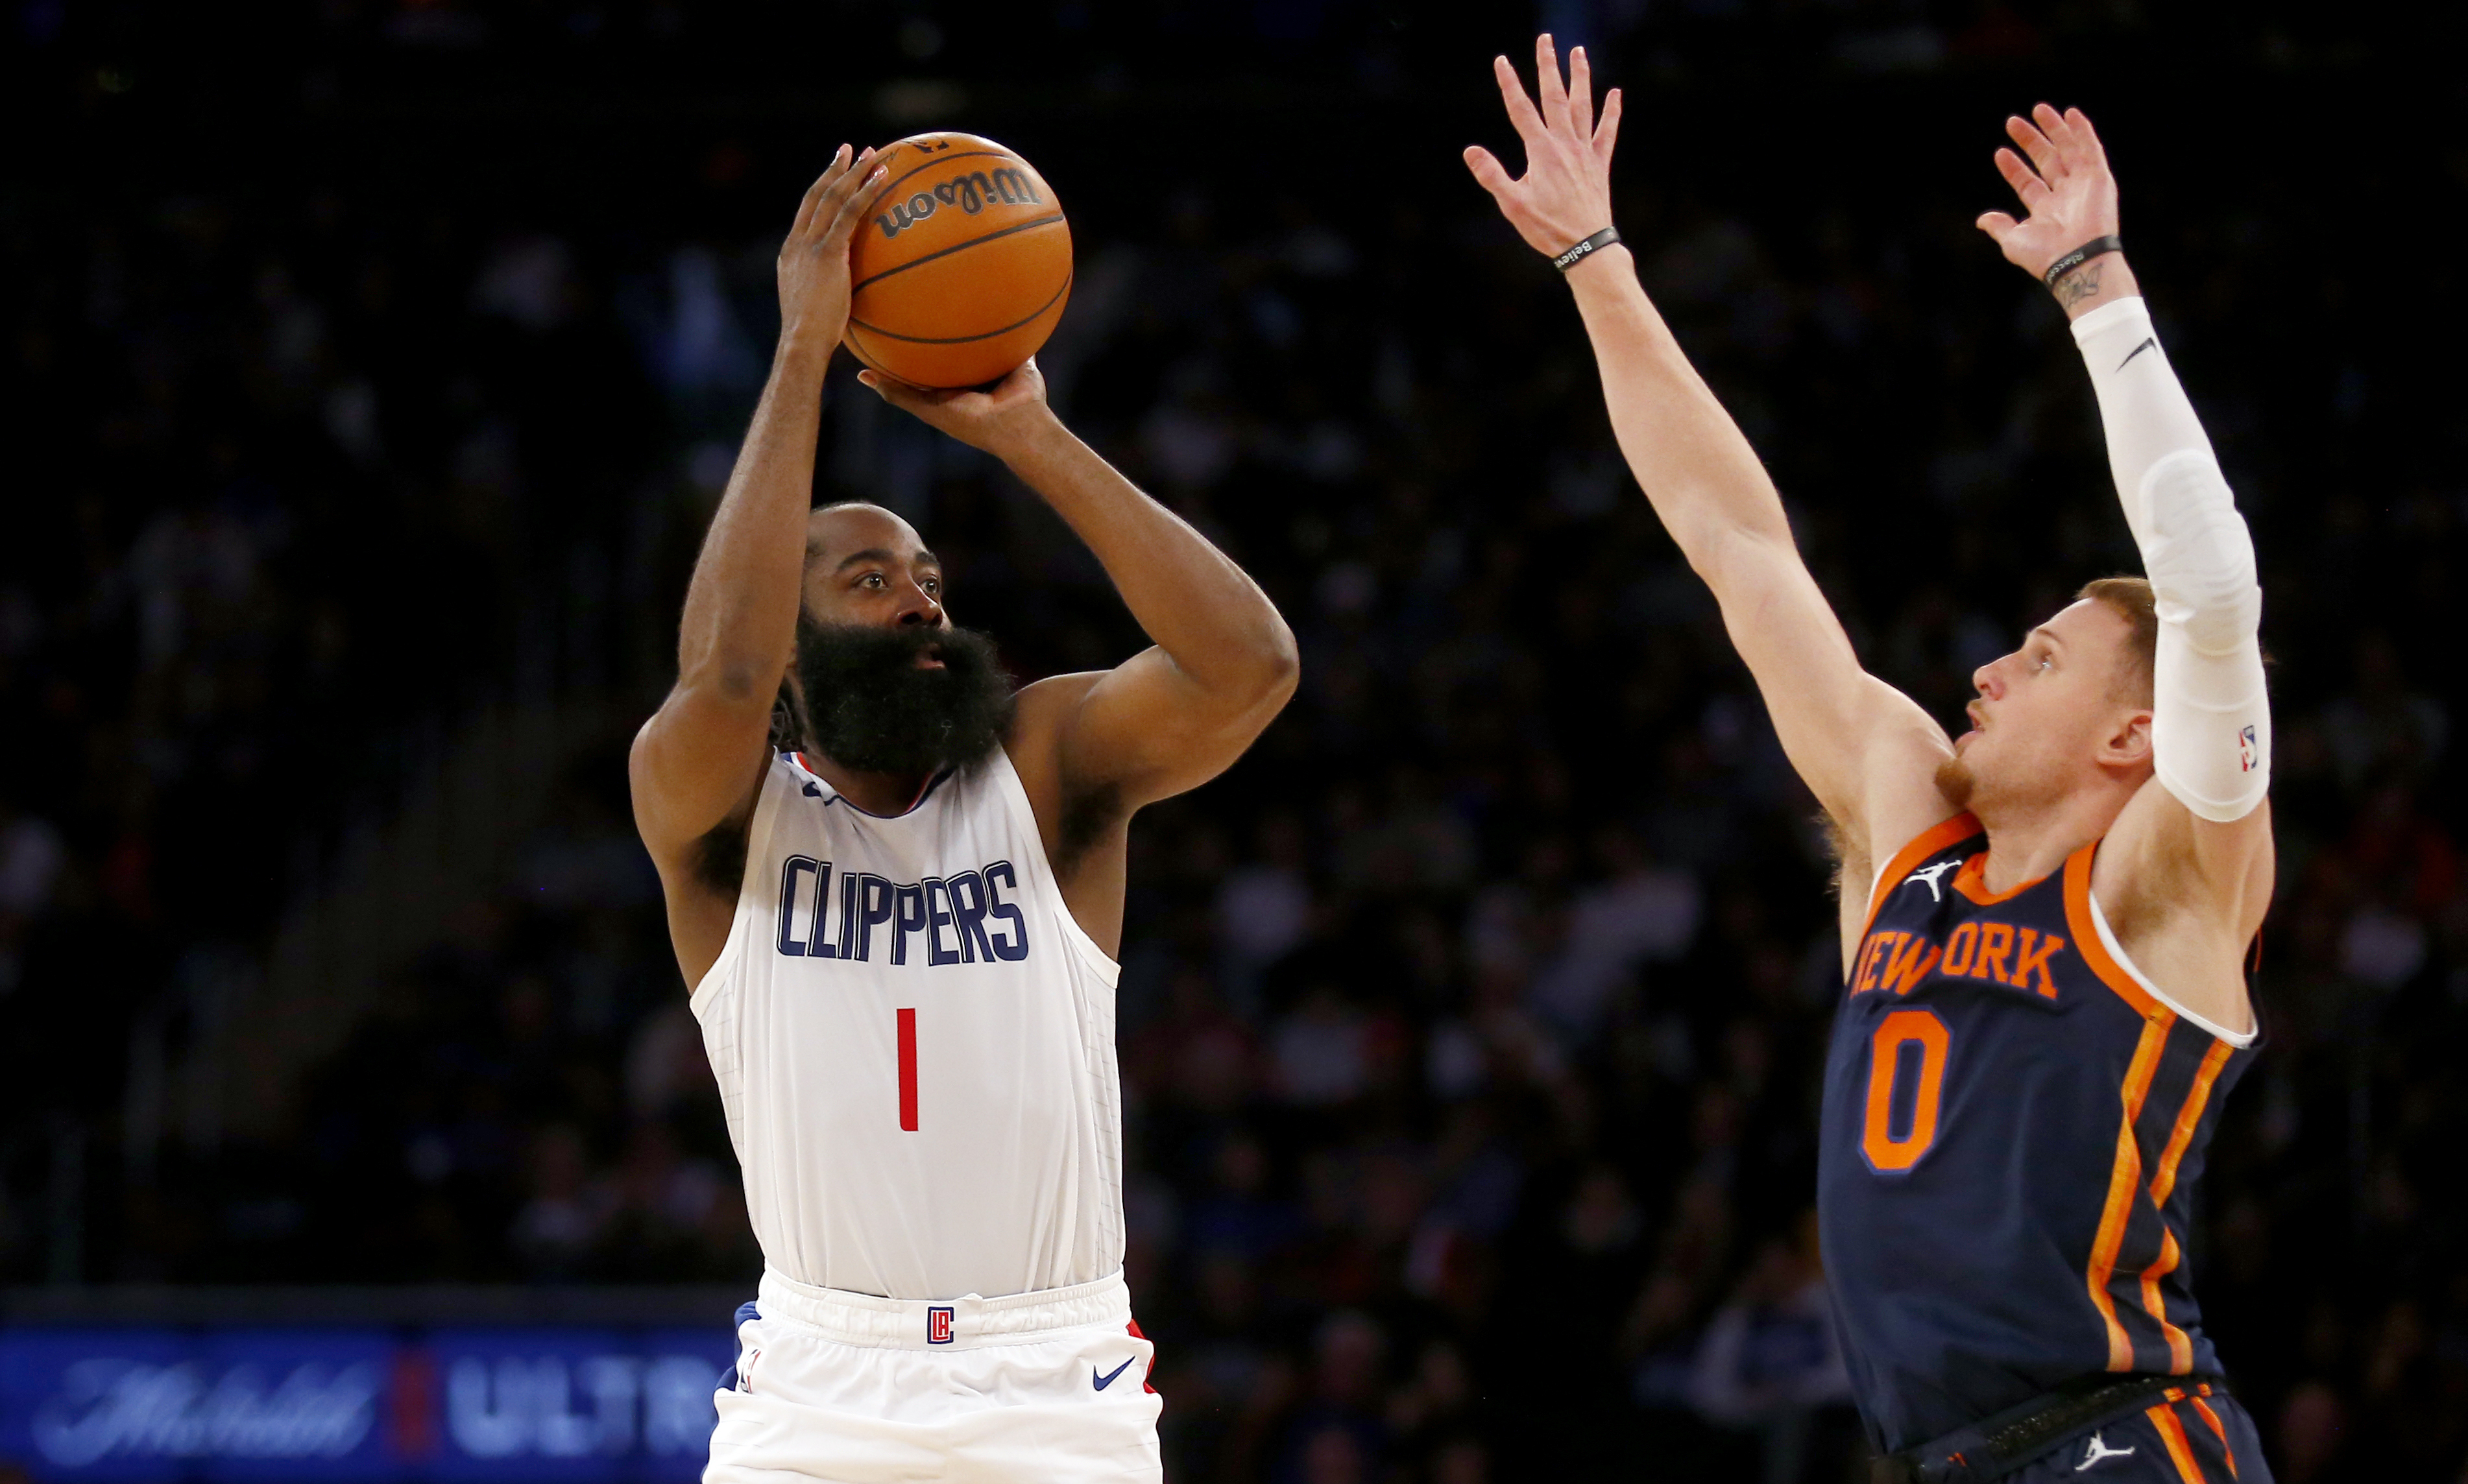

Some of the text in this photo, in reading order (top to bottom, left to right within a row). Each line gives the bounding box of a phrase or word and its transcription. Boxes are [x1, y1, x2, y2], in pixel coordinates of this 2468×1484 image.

[876, 168, 1041, 239] Wilson
[1554, 241, 1593, 268] Believ
[777, 854, 1029, 967] CLIPPERS
[1939, 921, 2066, 1000] ORK
[896, 1007, 919, 1132] 1
[1859, 1005, 1953, 1175] 0
